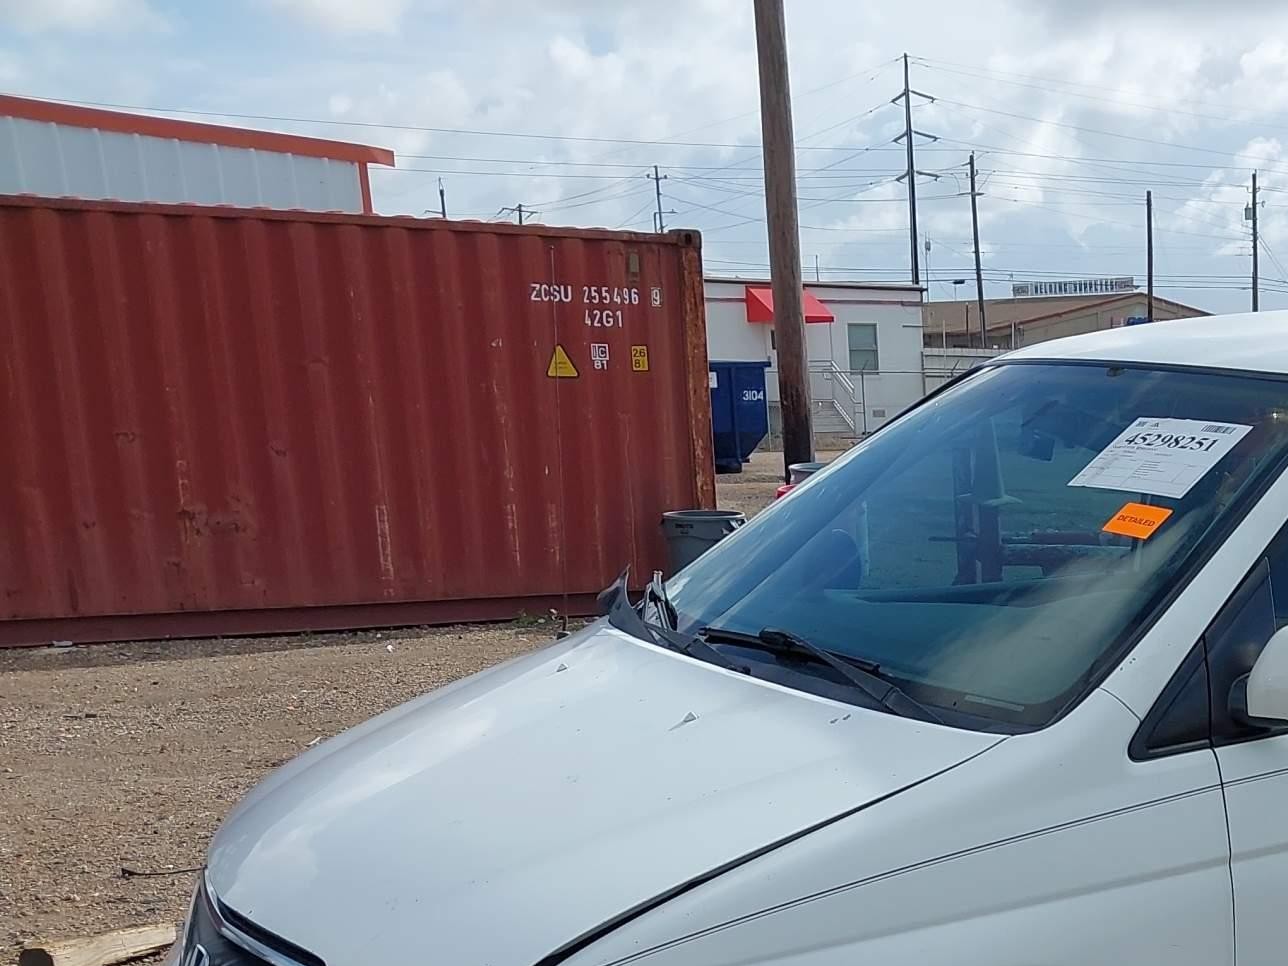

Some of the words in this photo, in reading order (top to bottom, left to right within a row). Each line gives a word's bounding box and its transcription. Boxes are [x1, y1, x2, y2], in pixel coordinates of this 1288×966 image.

[530, 284, 572, 303] ZCSU
[583, 286, 639, 305] 255496
[652, 288, 661, 306] 9
[585, 310, 623, 328] 42G1
[742, 390, 764, 401] 3104
[1124, 432, 1221, 452] 45298251
[1116, 514, 1156, 528] DETAILED
